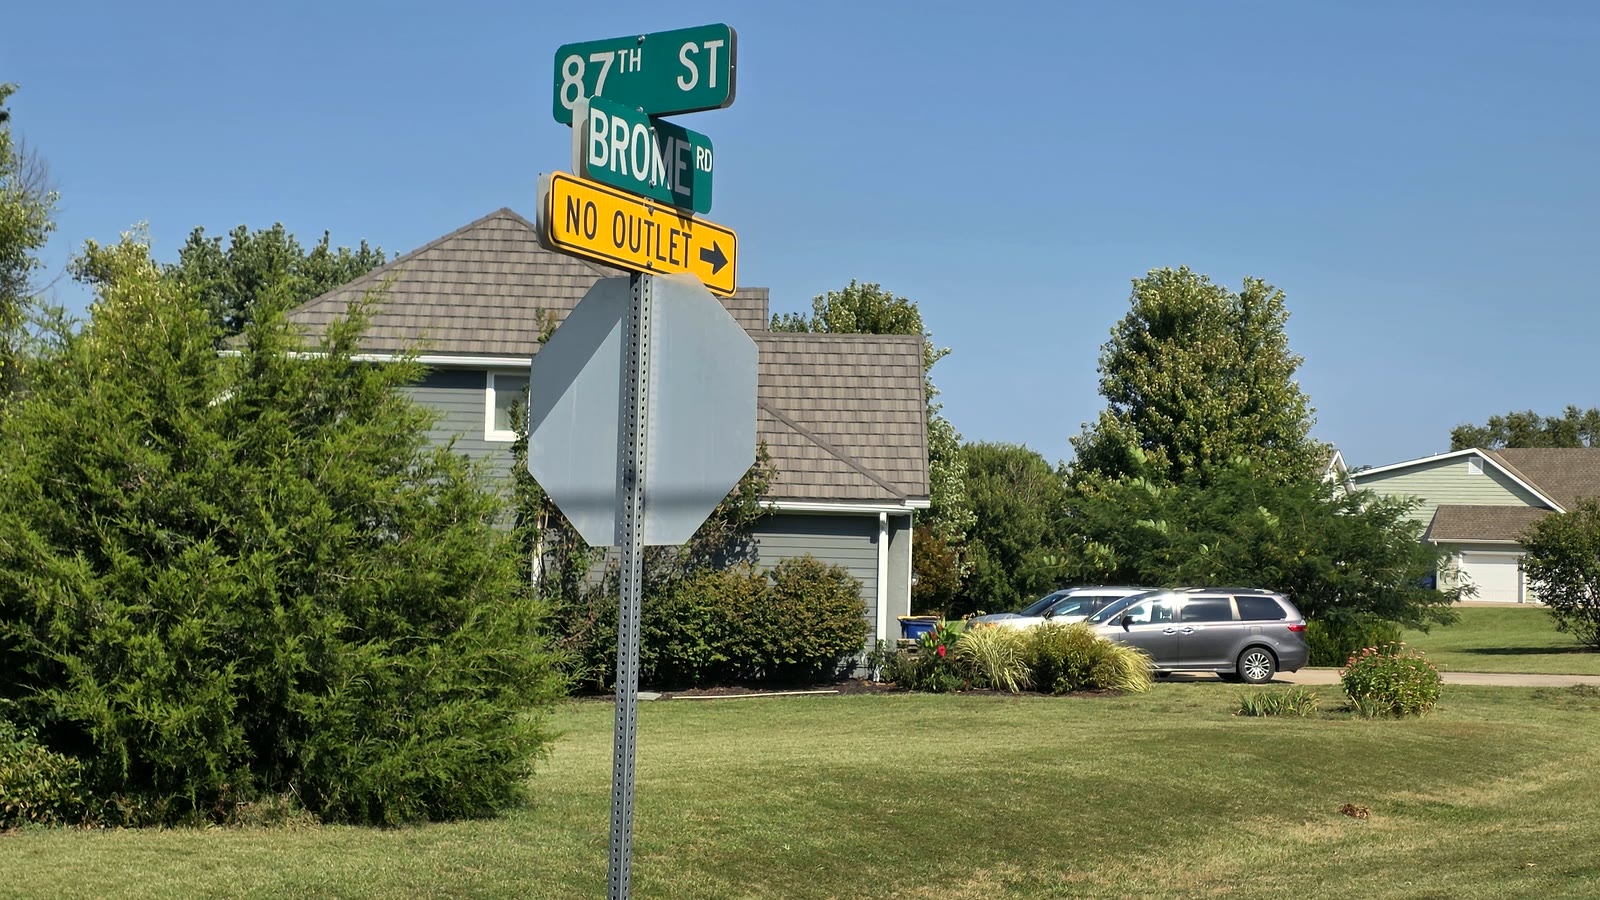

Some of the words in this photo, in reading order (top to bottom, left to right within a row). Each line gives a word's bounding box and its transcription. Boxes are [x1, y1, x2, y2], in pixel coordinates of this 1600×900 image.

[560, 48, 641, 110] 87TH
[677, 40, 724, 91] ST
[589, 107, 691, 196] BROME
[696, 145, 713, 173] RD
[566, 195, 598, 240] NO
[613, 210, 692, 269] OUTLET
